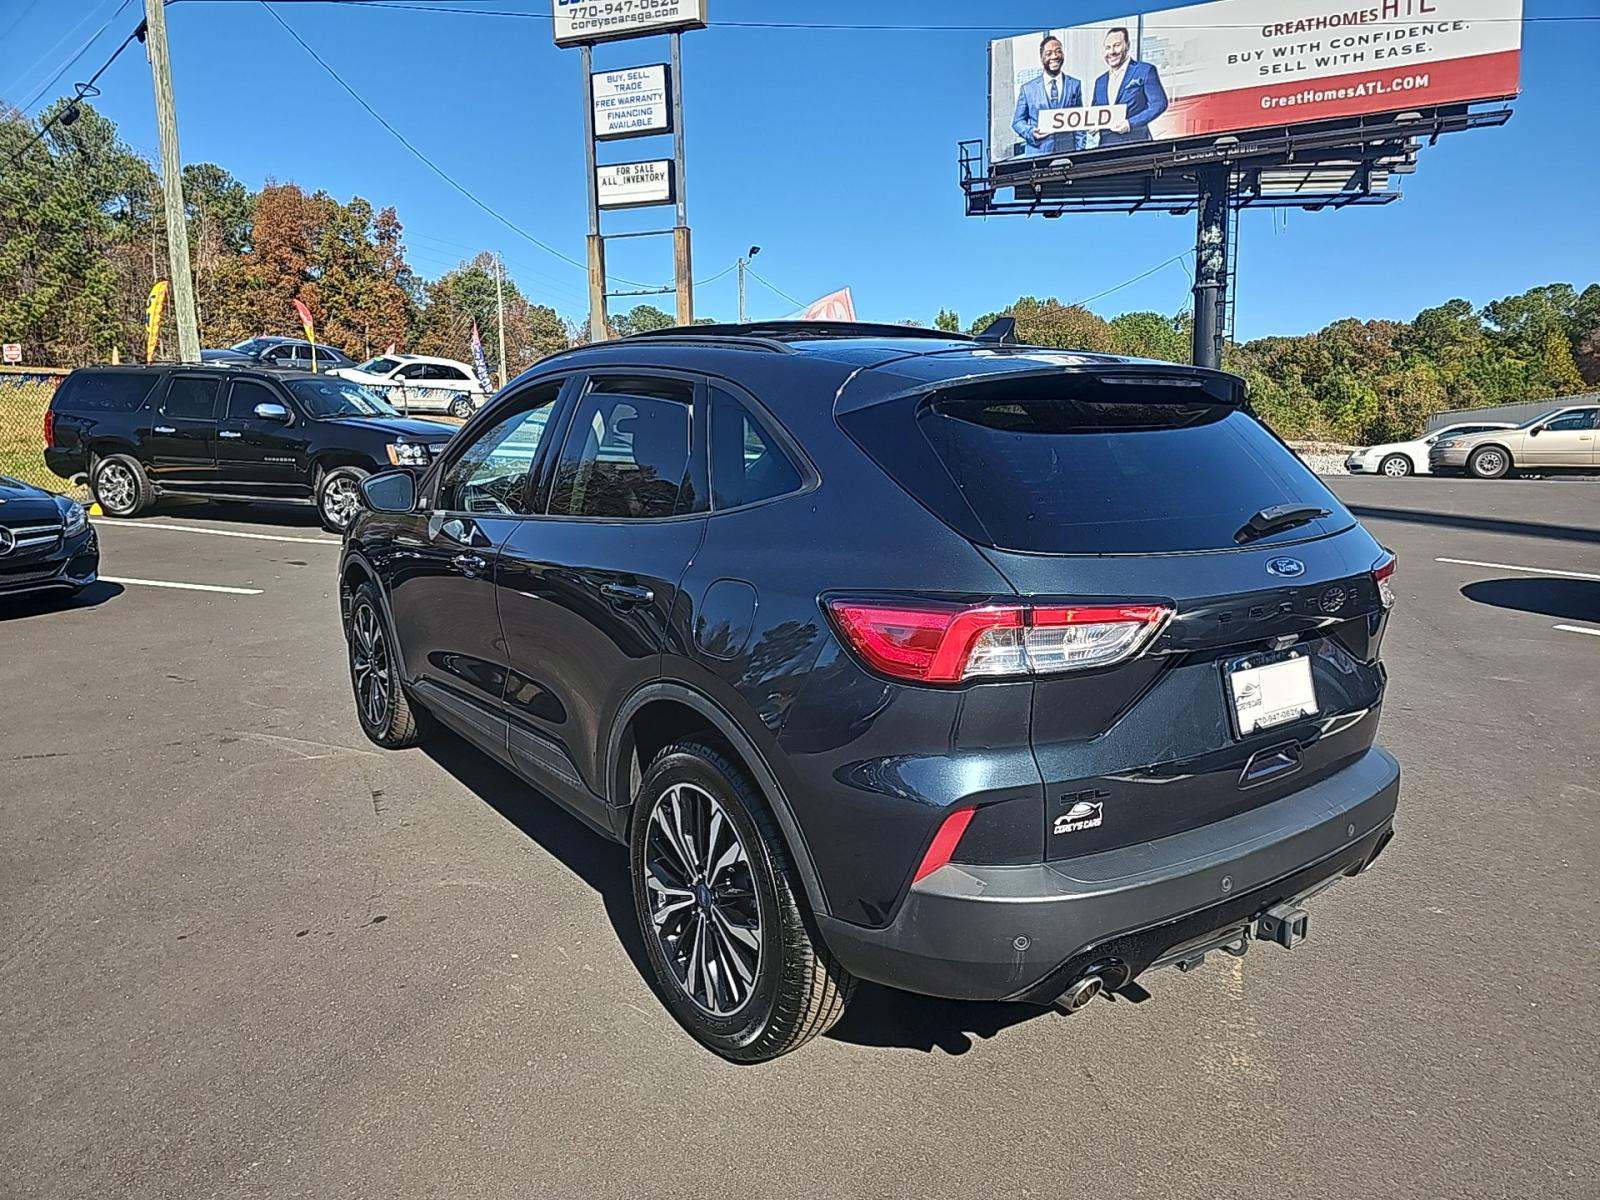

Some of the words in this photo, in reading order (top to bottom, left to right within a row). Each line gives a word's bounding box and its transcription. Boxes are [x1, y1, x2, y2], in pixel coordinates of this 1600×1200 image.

[571, 6, 679, 30] coreyscarsga.com
[1227, 49, 1264, 65] BUY
[1273, 41, 1321, 58] WITH
[1329, 20, 1471, 49] CONFIDENCE.
[1259, 61, 1307, 76] SELL
[1315, 52, 1365, 68] WITH
[1374, 43, 1433, 60] EASE.
[614, 81, 643, 92] TRADE
[1260, 74, 1430, 110] GreatHomesATL.COM
[596, 98, 616, 109] FREE
[618, 92, 664, 106] WARRANTY
[607, 107, 653, 121] FINANCING
[1051, 108, 1112, 129] SOLD
[608, 118, 653, 130] AVAILABLE
[616, 167, 631, 176] FOR
[634, 164, 655, 175] SALE
[602, 177, 617, 186] ALL
[623, 172, 665, 185] INVENTORY
